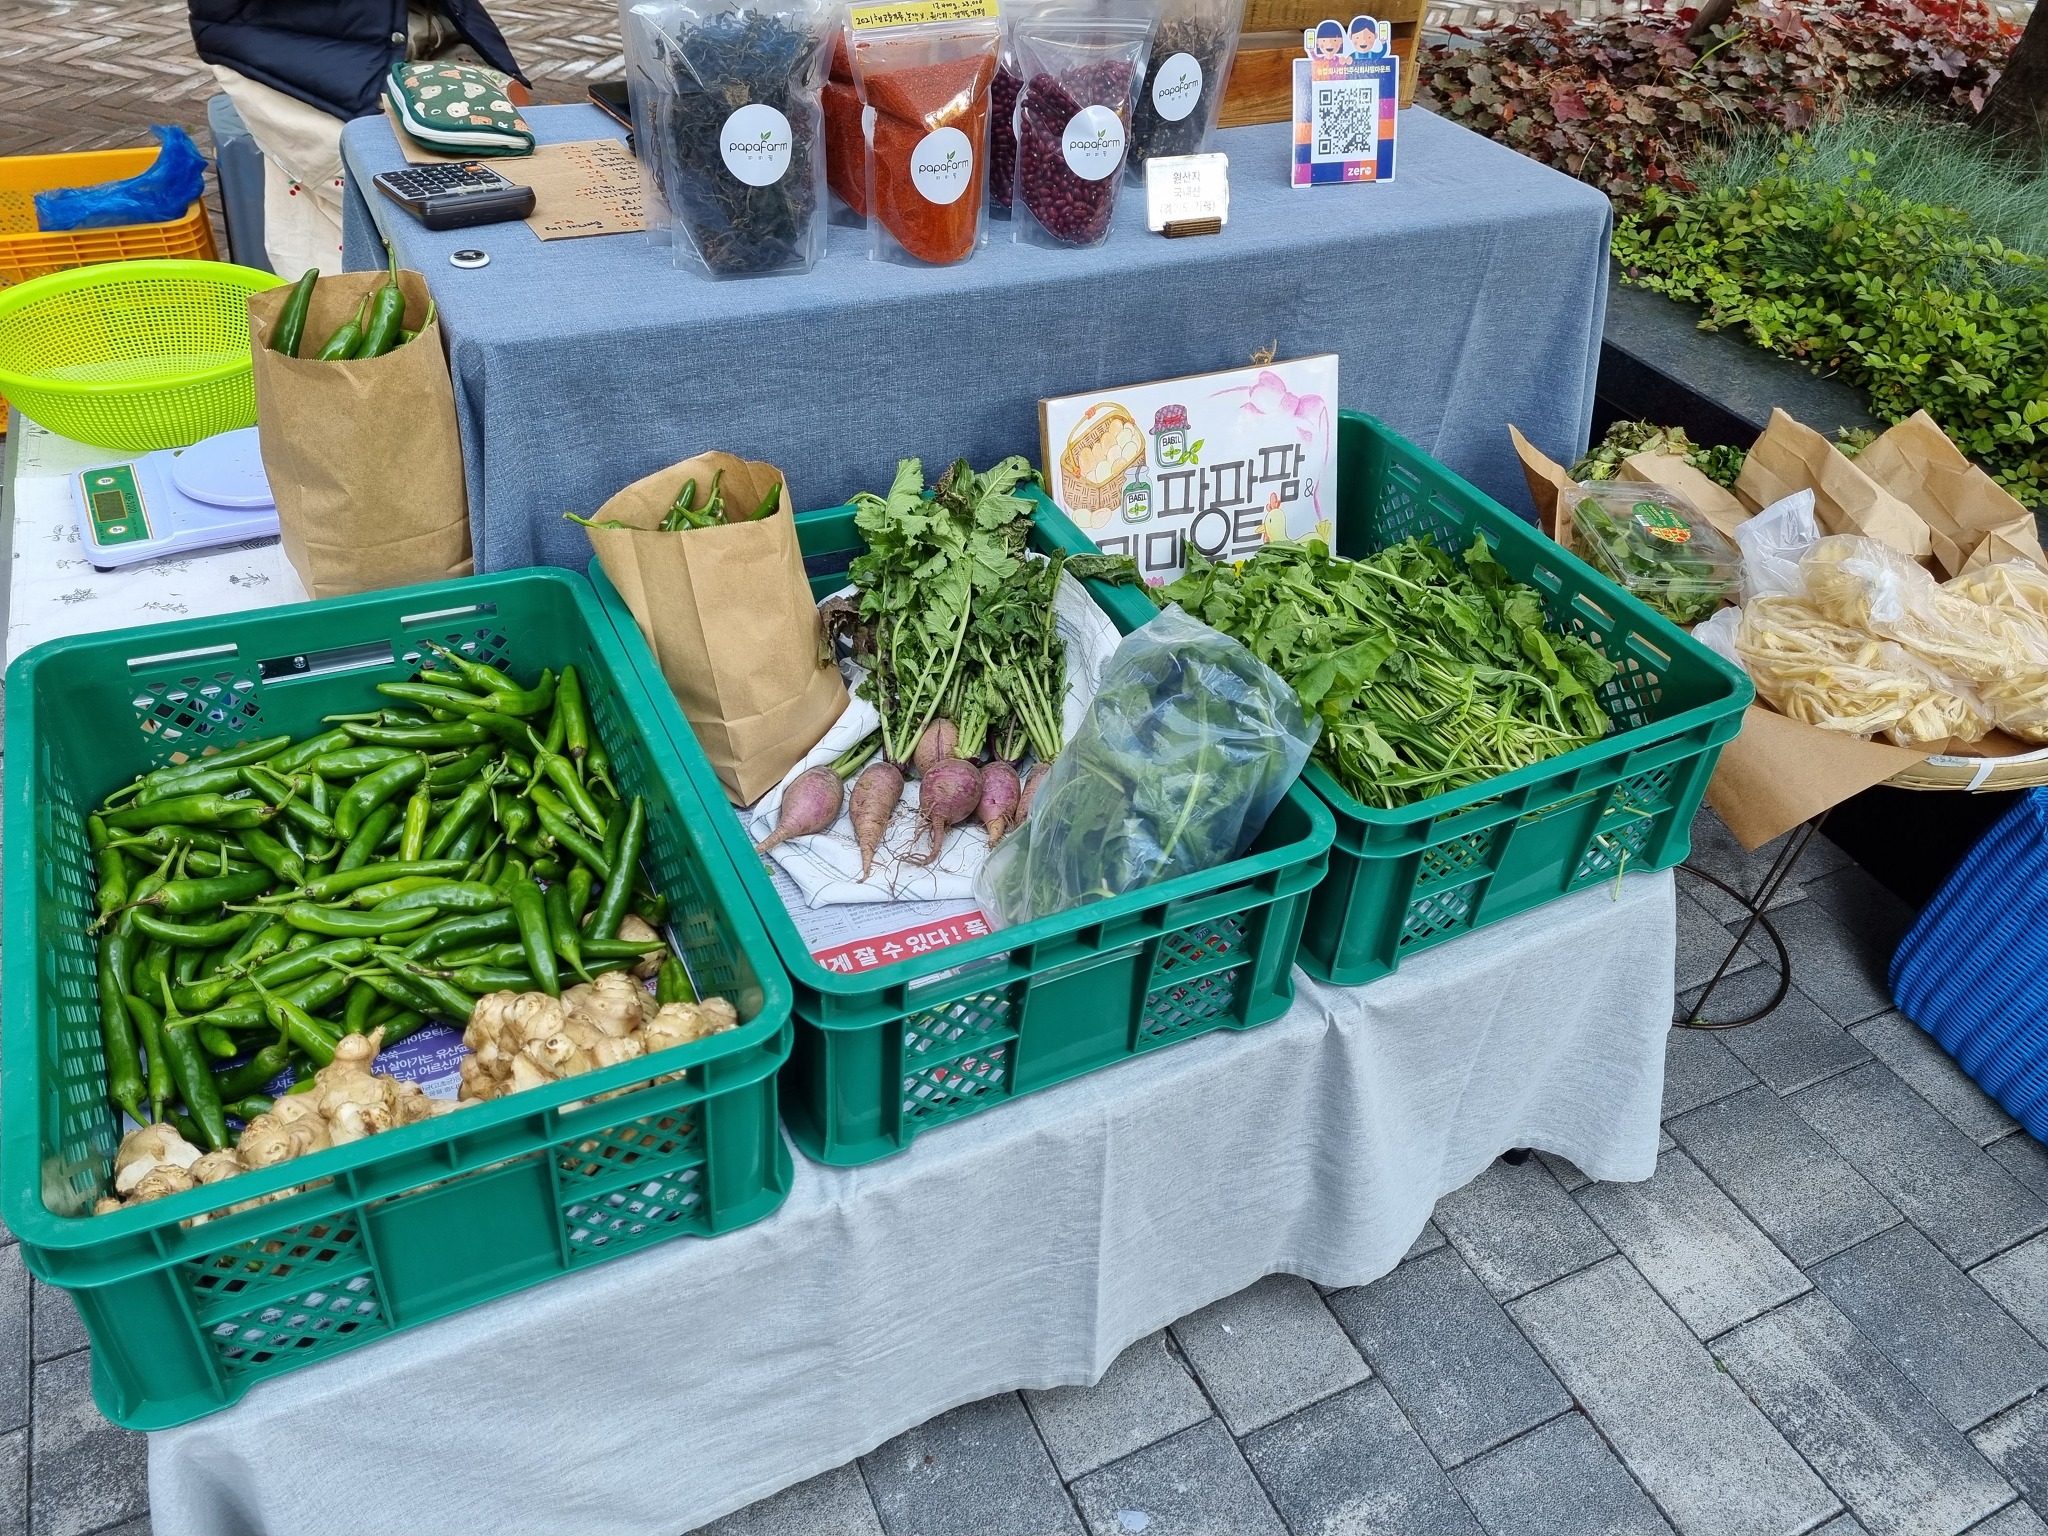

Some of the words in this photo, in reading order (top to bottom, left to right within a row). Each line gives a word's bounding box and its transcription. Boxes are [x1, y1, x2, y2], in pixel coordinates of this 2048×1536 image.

[1158, 79, 1199, 99] papafarm
[729, 140, 788, 153] papafarm
[1069, 137, 1121, 151] papafarm
[918, 159, 969, 174] papafarm
[1347, 166, 1372, 176] zero
[1173, 171, 1200, 184] 원산지
[1157, 444, 1305, 518] 파파팜
[853, 946, 879, 967] 잘
[881, 941, 904, 959] 수
[388, 1054, 434, 1071] 살아가는
